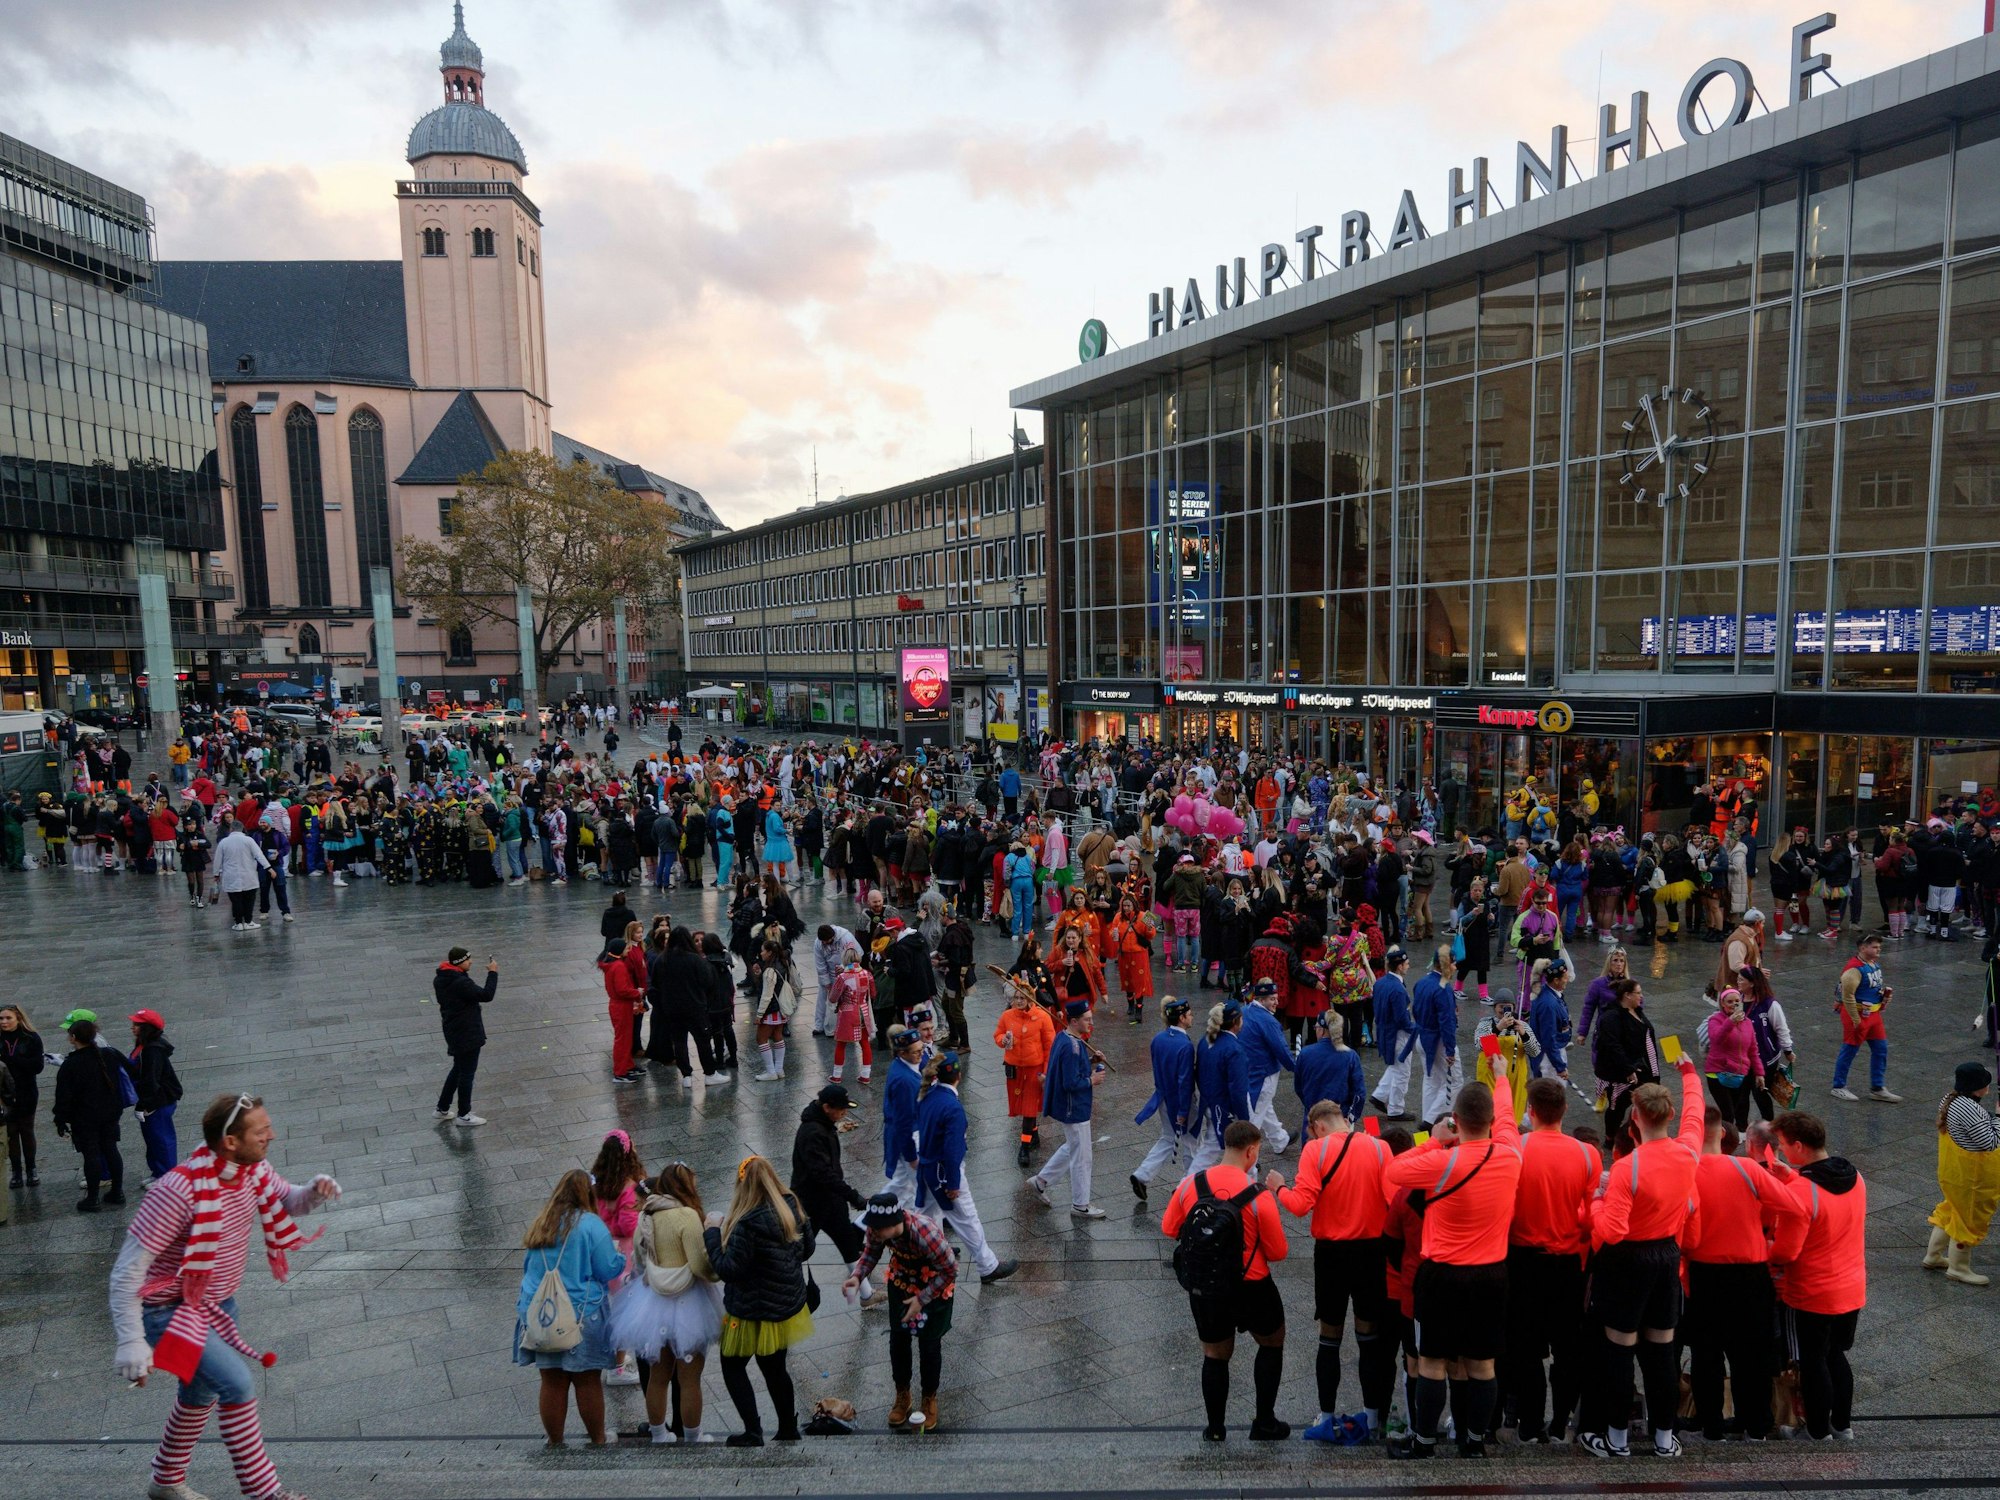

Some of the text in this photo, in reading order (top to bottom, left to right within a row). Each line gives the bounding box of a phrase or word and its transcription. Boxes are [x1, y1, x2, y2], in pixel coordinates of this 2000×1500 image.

[1148, 12, 1837, 338] HAUPTBAHNHOF
[1082, 324, 1098, 362] S
[1181, 500, 1210, 509] SERIEN
[1181, 509, 1206, 518] FILME
[2, 631, 33, 645] Bank
[1491, 672, 1526, 681] Leonidas
[1107, 691, 1118, 699] BODY
[1118, 691, 1130, 699] SHOP
[1176, 690, 1278, 706] NetCologne Highspeed
[1299, 693, 1433, 711] NetCologne Highspeed
[1478, 704, 1537, 730] Kamps
